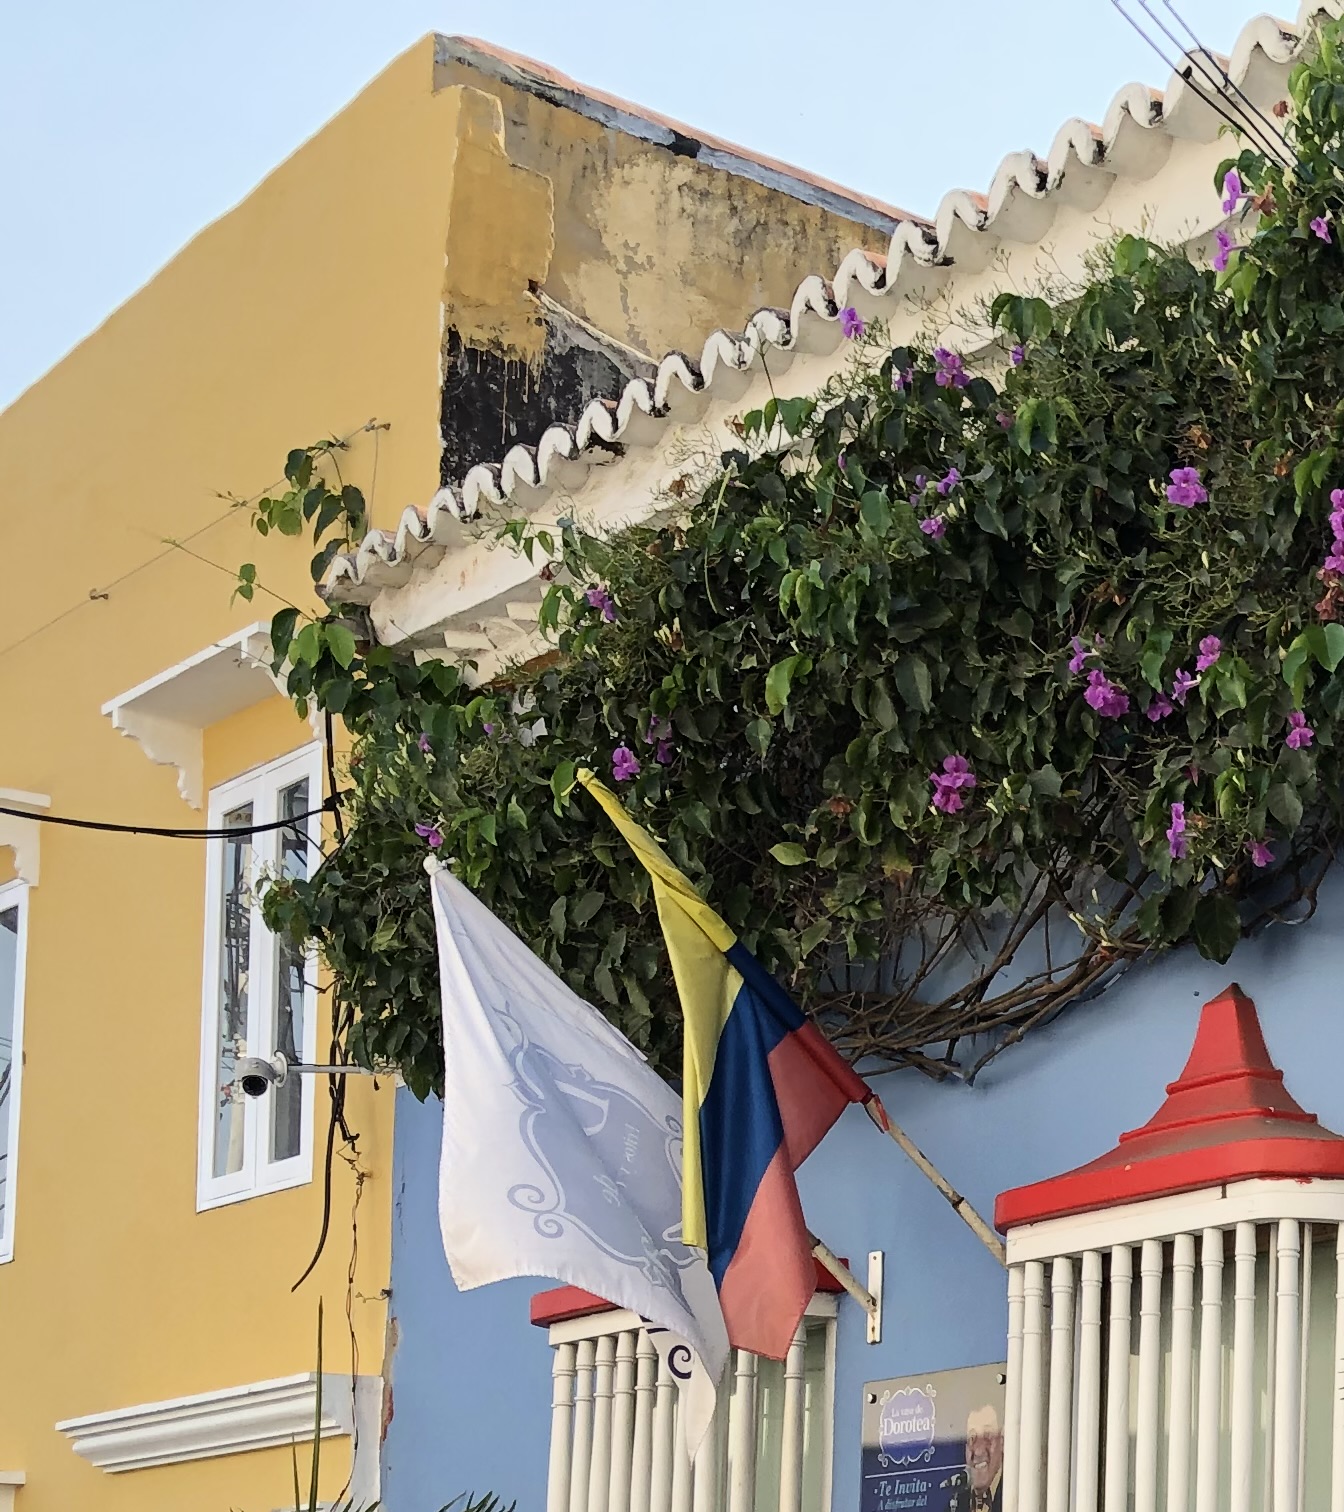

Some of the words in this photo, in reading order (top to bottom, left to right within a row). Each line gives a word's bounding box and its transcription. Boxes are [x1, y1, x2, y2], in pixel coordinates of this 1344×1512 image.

[884, 1416, 930, 1436] Dorotea
[880, 1480, 892, 1496] Te
[894, 1478, 926, 1494] Invita
